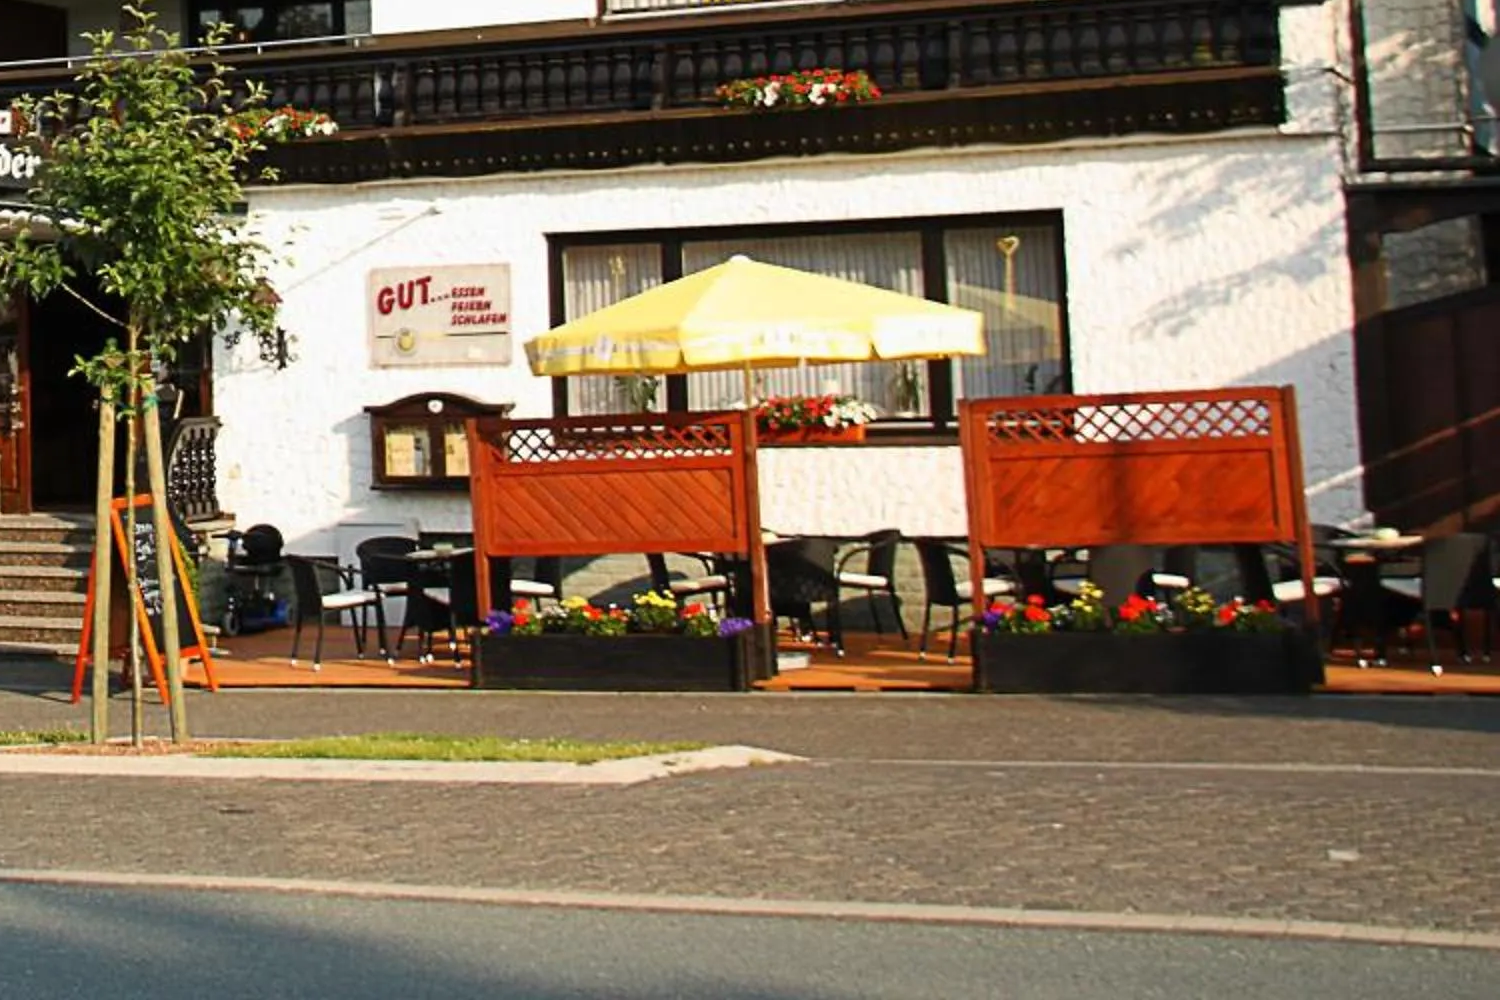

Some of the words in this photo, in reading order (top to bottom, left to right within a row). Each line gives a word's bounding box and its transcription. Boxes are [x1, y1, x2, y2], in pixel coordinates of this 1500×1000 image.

[451, 286, 485, 299] ESSEN
[451, 301, 492, 312] FEIERN
[451, 314, 507, 326] SCHLAFEN
